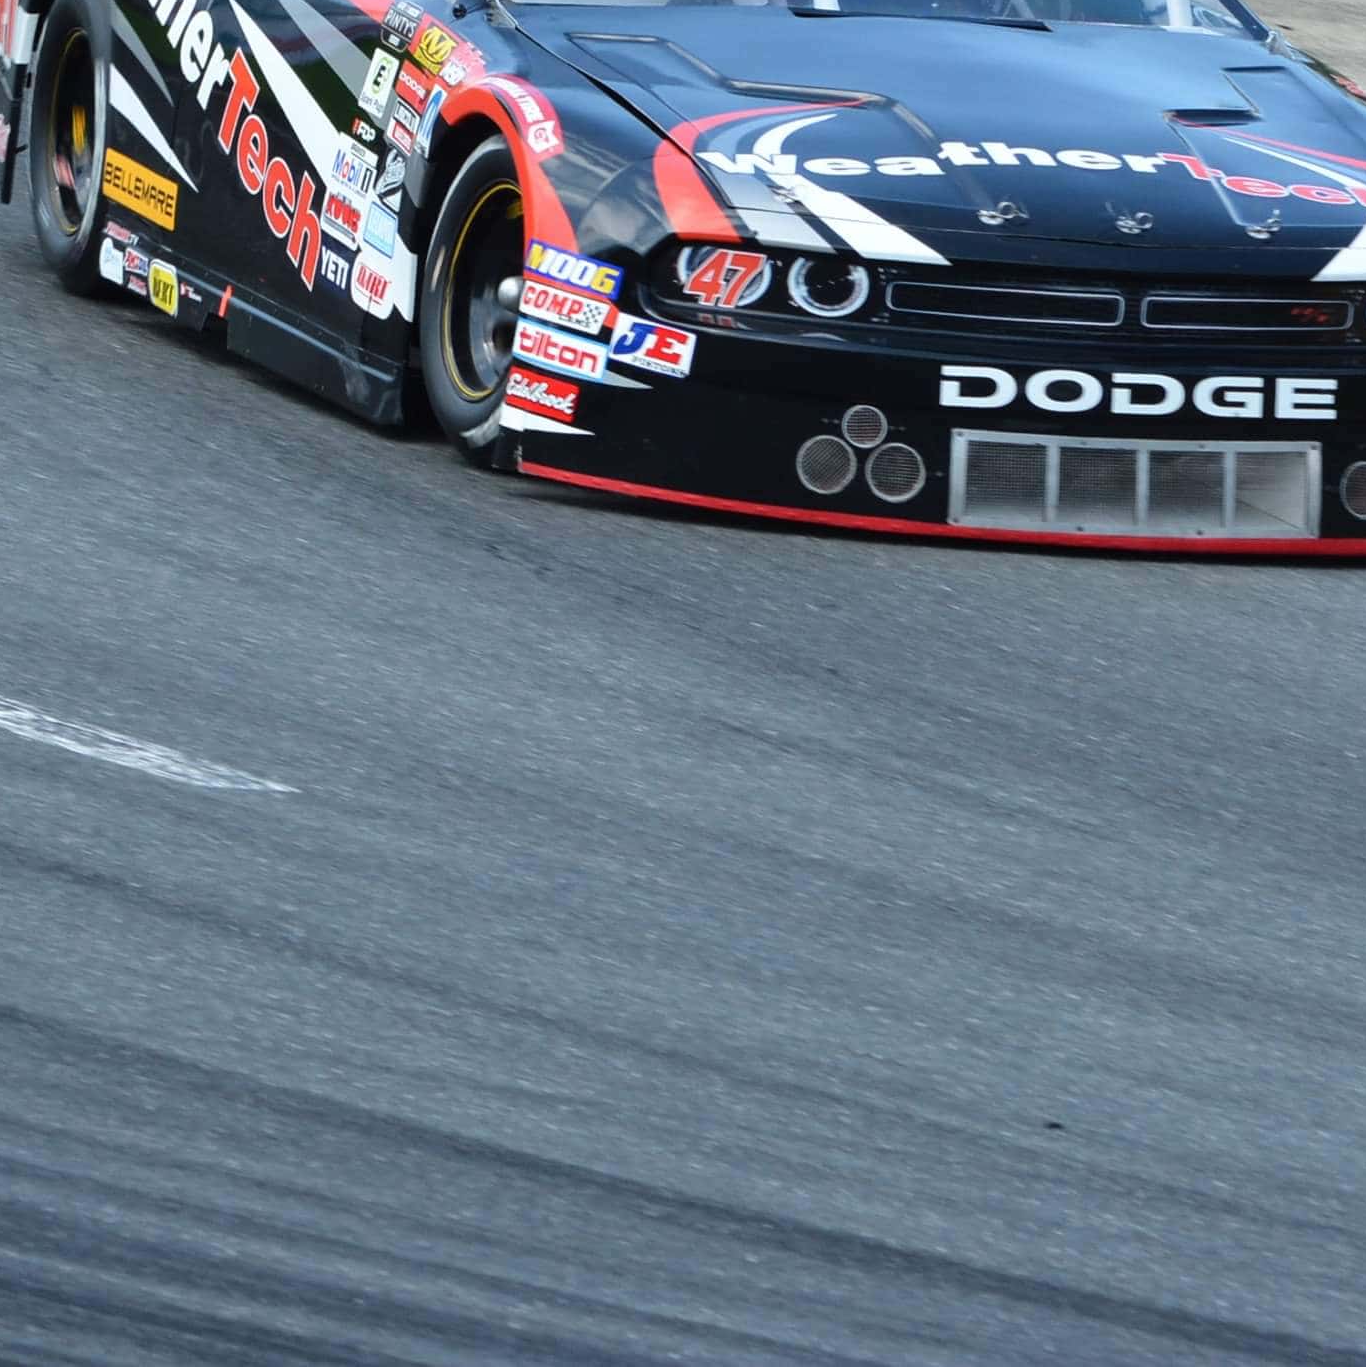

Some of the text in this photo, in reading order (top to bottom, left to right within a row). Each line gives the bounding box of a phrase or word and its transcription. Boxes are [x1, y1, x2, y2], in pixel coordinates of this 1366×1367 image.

[104, 162, 176, 218] BELLEMARE
[321, 245, 350, 291] YETI
[527, 242, 621, 295] MOOG
[682, 248, 768, 308] 47
[522, 285, 583, 317] COMP
[519, 327, 598, 373] tilton
[612, 322, 689, 365] JE
[505, 372, 577, 415] Edelbrock
[939, 365, 1338, 419] DODGE
